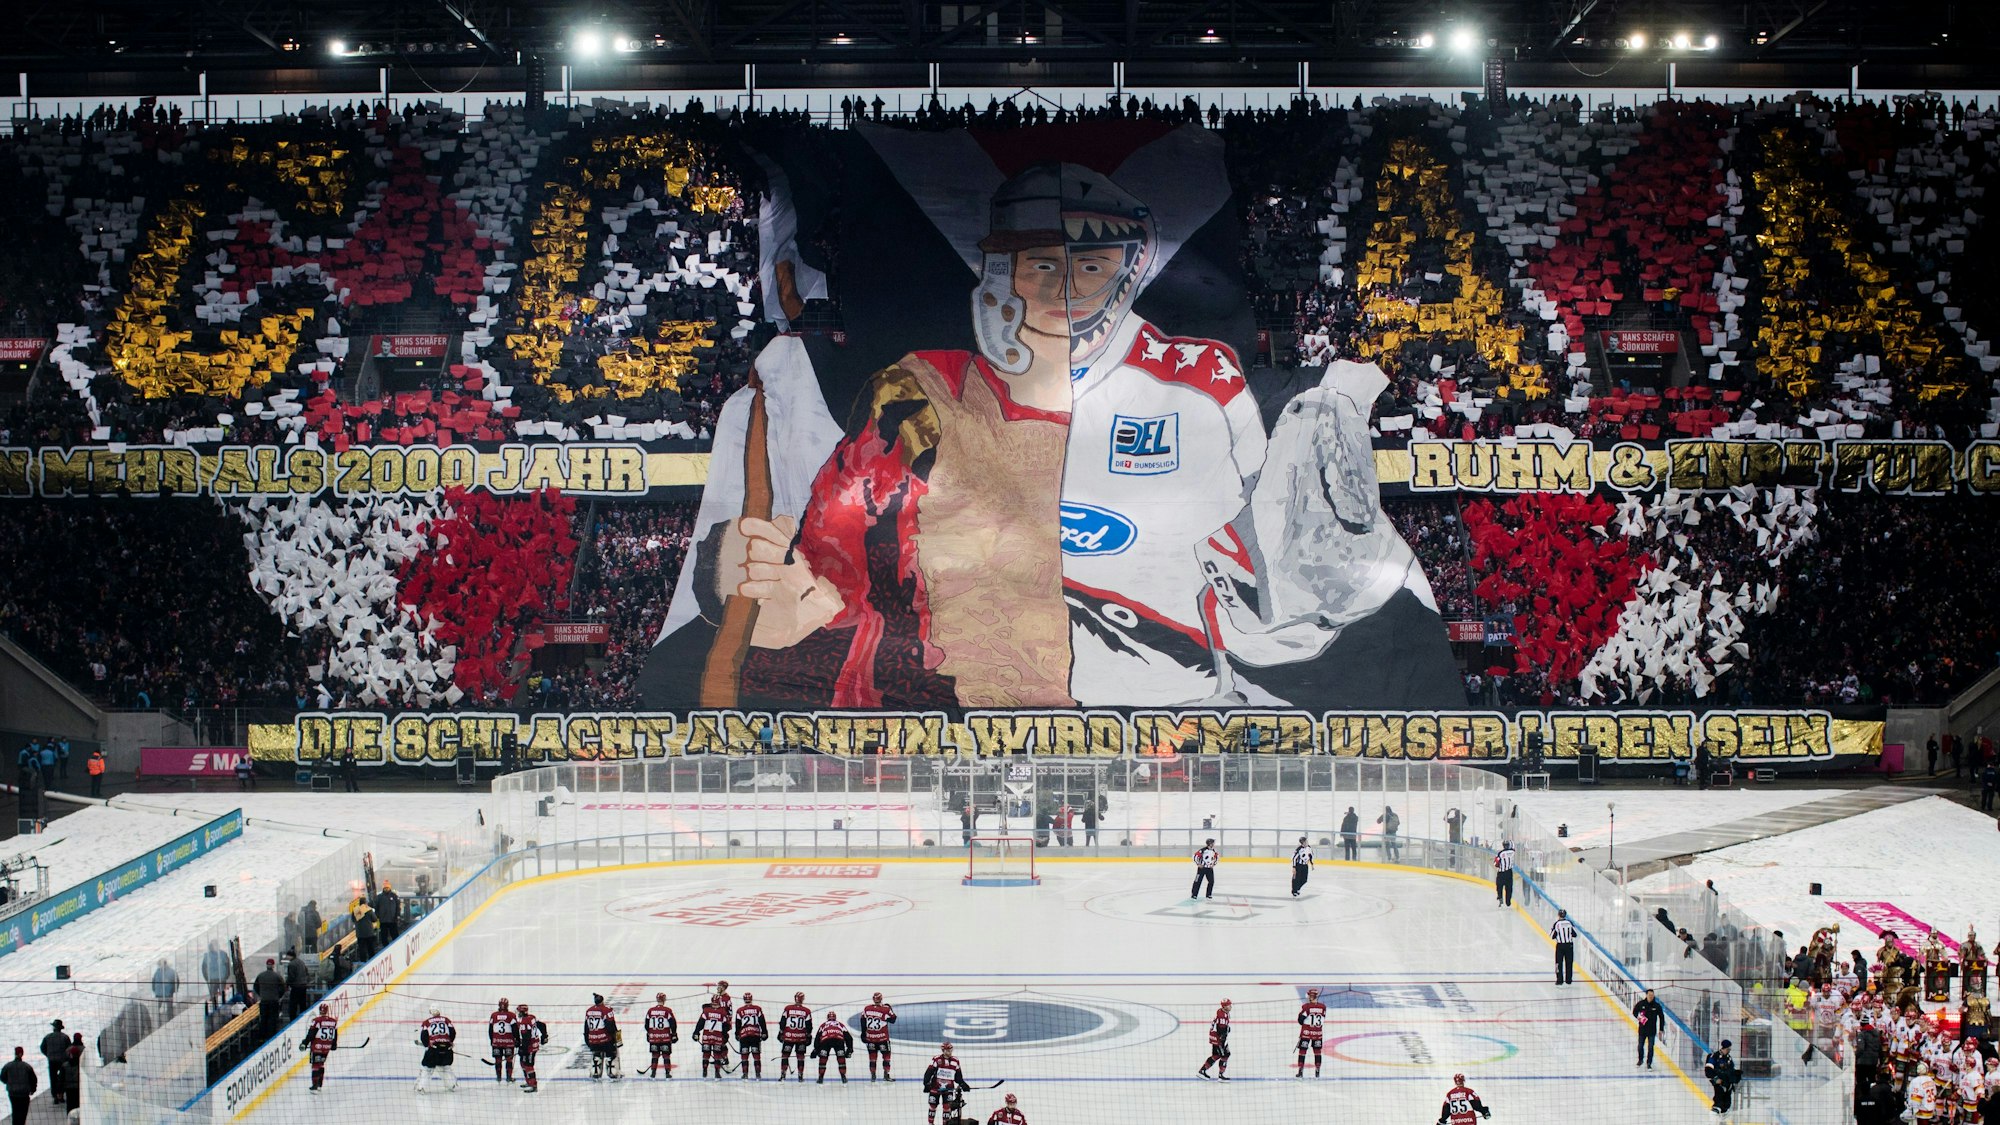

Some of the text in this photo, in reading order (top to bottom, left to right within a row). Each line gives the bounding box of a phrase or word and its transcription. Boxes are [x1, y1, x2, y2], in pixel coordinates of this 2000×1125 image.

[395, 336, 447, 346] HANS SCHÄFER
[1622, 332, 1675, 342] HANS SCHÄFER
[395, 346, 432, 355] SÜDKURVE
[1622, 342, 1659, 351] SÜDKURVE
[1115, 418, 1171, 457] DEL
[42, 447, 197, 493] MEHR
[211, 448, 326, 493] ALS
[336, 446, 478, 493] 2000
[488, 446, 646, 492] JAHR
[1134, 460, 1175, 469] BUNDESLIGA
[1412, 441, 1592, 490] RUHM
[1609, 444, 1656, 490] &
[554, 625, 604, 634] HANS SCHÄFER
[1460, 623, 1478, 632] HANS
[554, 633, 589, 642] SÜDKURVE
[297, 715, 384, 762] DIE
[968, 714, 1124, 758] WIRD
[1134, 713, 1313, 758] IMMER
[1326, 714, 1507, 761] UNSER
[1518, 714, 1692, 759] LEBEN
[1703, 712, 1831, 758] SEIN
[162, 838, 198, 870] sportwetten.de
[771, 865, 876, 877] EXPRESS
[104, 863, 147, 899] sportwetten.de
[39, 891, 87, 931] sportwetten.de
[650, 891, 803, 919] Rhein
[680, 889, 871, 928] Energie
[367, 953, 394, 991] TOYOTA
[498, 1020, 506, 1035] 3
[588, 1016, 601, 1031] 67
[709, 1019, 718, 1031] 7
[743, 1015, 758, 1027] 21
[789, 1015, 805, 1030] 50
[867, 1016, 881, 1031] 23
[1309, 1014, 1322, 1027] 13
[320, 1027, 336, 1041] 59
[430, 1022, 447, 1036] 29
[226, 1036, 292, 1115] sportwetten.de
[1450, 1099, 1468, 1114] 55
